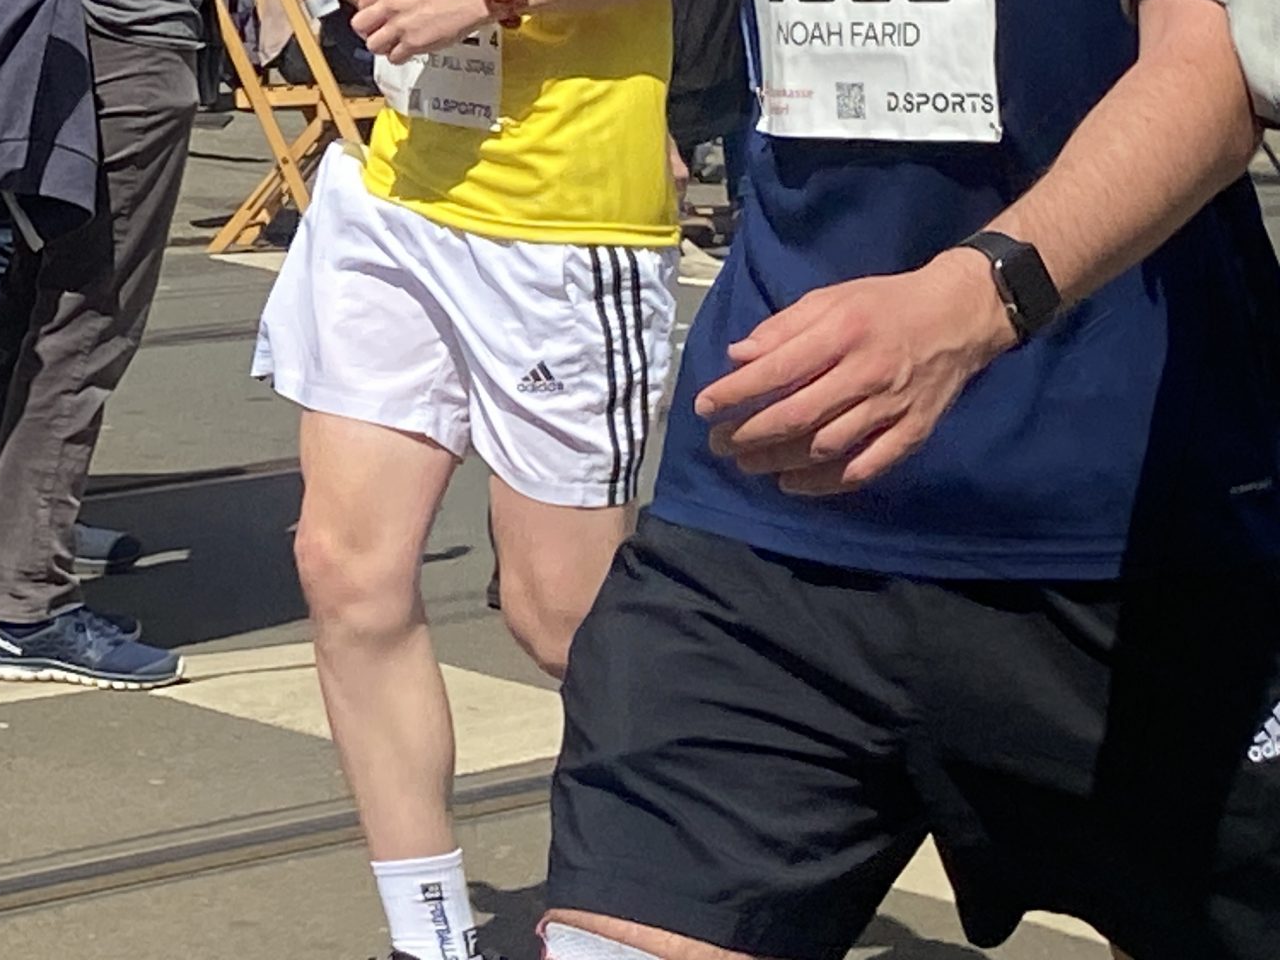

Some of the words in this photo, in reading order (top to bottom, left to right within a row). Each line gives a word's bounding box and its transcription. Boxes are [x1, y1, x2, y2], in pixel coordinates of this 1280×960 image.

[777, 21, 843, 47] NOAH
[850, 22, 920, 47] FARID
[887, 91, 994, 114] D.SPORTS
